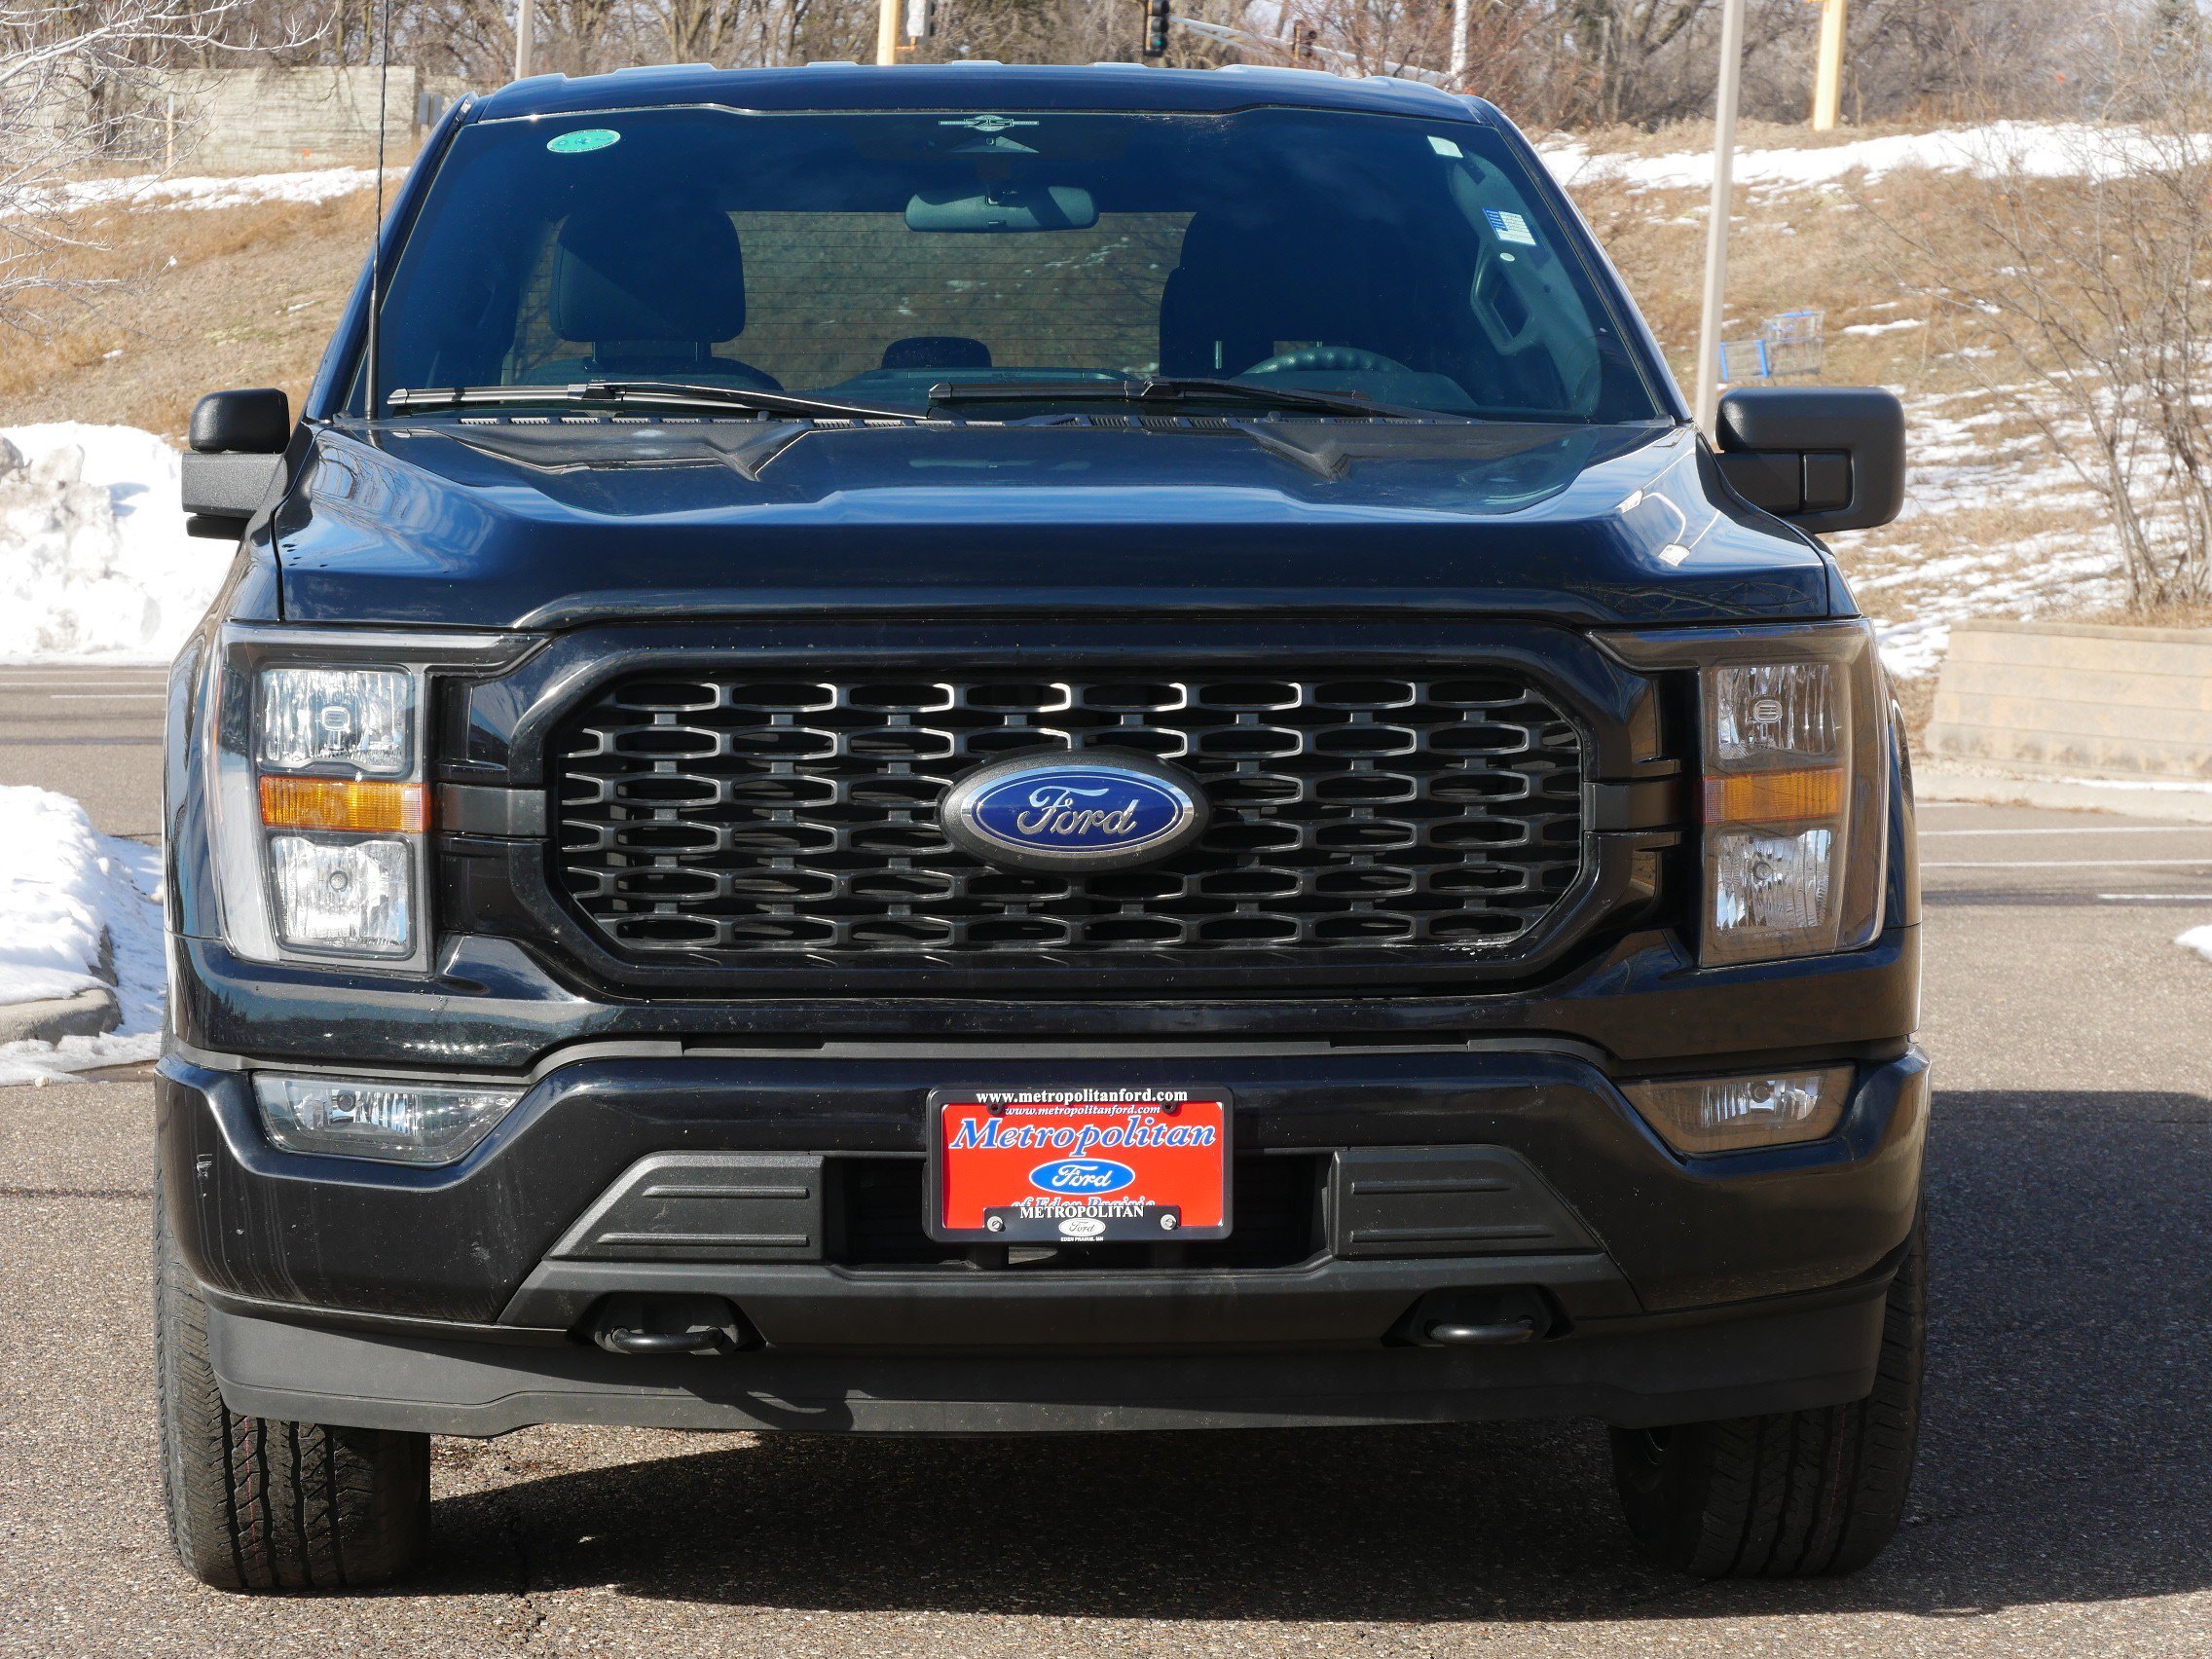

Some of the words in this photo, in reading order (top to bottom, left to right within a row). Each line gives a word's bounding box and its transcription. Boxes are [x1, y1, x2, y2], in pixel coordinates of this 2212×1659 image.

[1017, 785, 1140, 835] Ford
[976, 1088, 1188, 1106] www.metropolitanford.com
[1005, 1104, 1161, 1117] www.metropolitanford.com
[948, 1115, 1216, 1157] Metropolitan
[1051, 1164, 1113, 1187] Ford
[1019, 1205, 1144, 1219] METROPOLITAN
[1069, 1221, 1095, 1233] Ford
